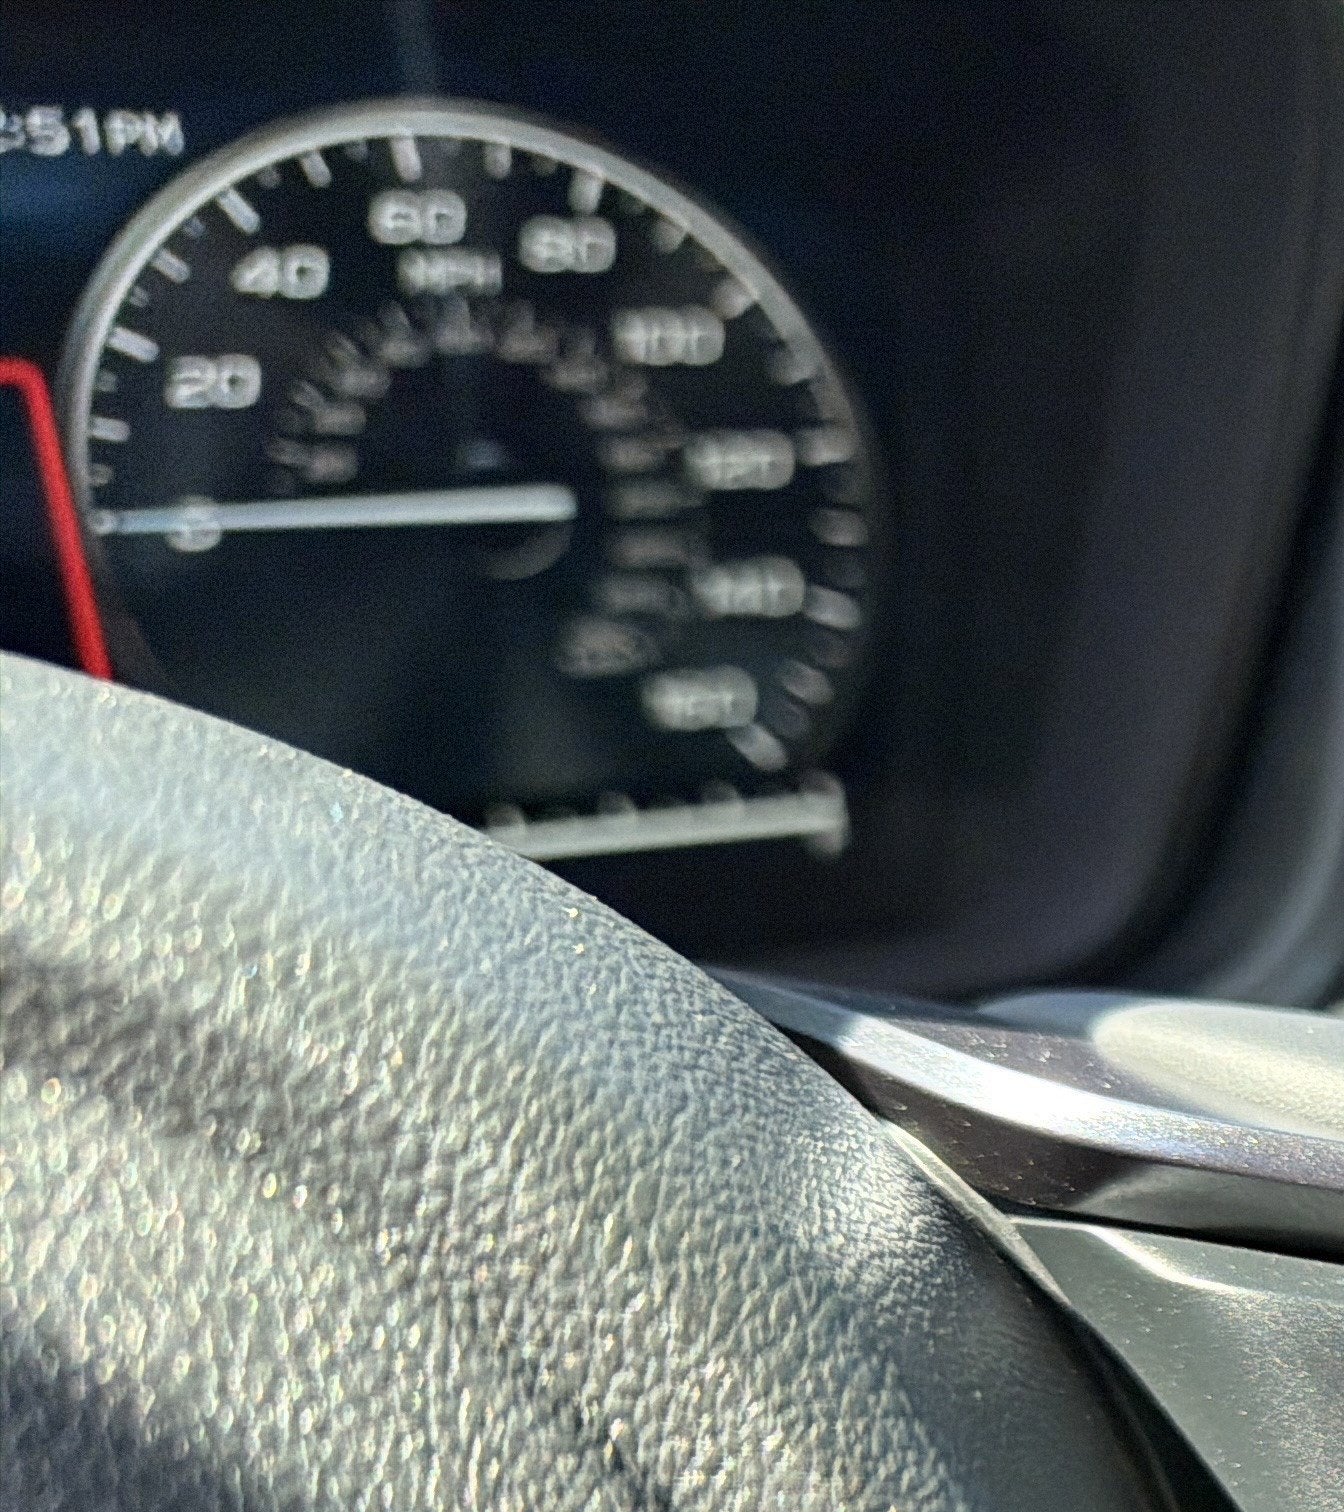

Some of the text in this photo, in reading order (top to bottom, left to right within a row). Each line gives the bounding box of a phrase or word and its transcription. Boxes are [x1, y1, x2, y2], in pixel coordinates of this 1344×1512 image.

[369, 190, 467, 246] 60
[230, 244, 330, 300] 40
[163, 354, 262, 410] 20
